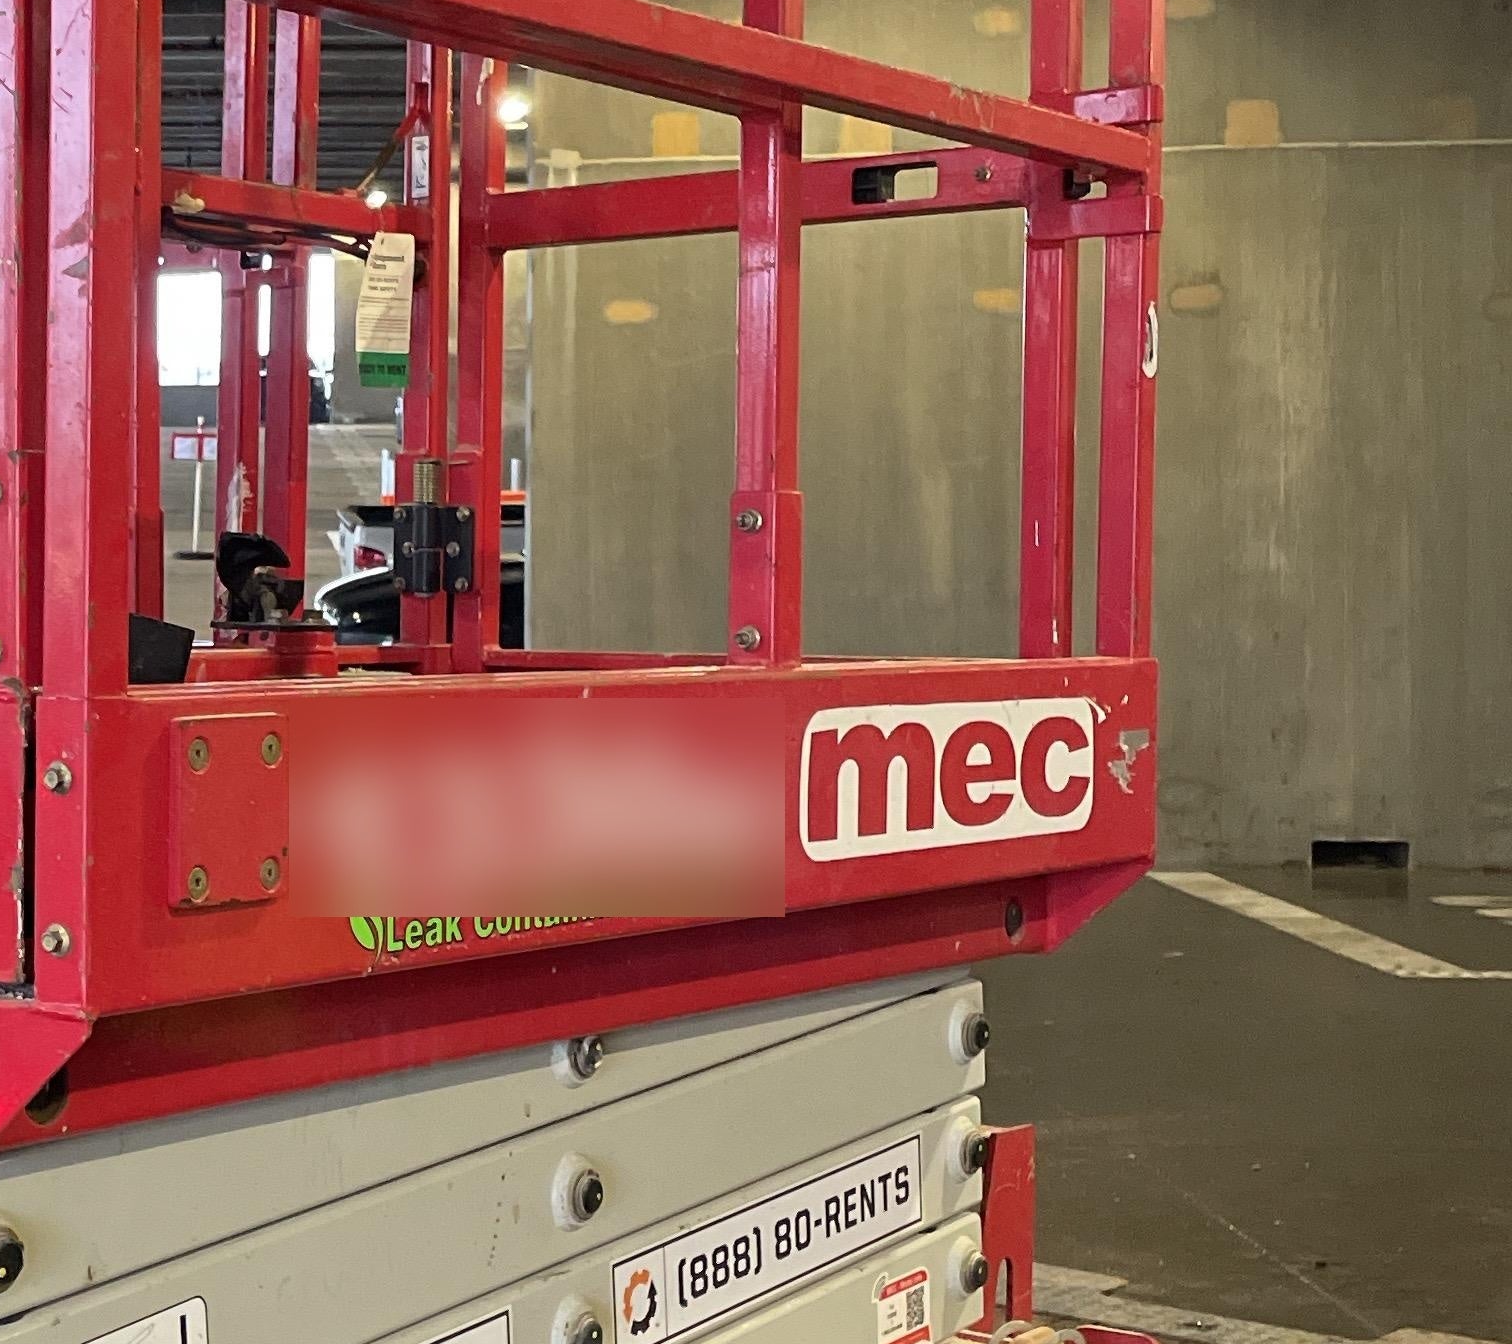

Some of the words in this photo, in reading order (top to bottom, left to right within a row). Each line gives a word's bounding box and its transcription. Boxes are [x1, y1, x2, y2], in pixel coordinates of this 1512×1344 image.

[387, 916, 463, 953] Leak
[677, 1225, 763, 1309] (888)
[774, 1164, 910, 1261] 80-RENTS
